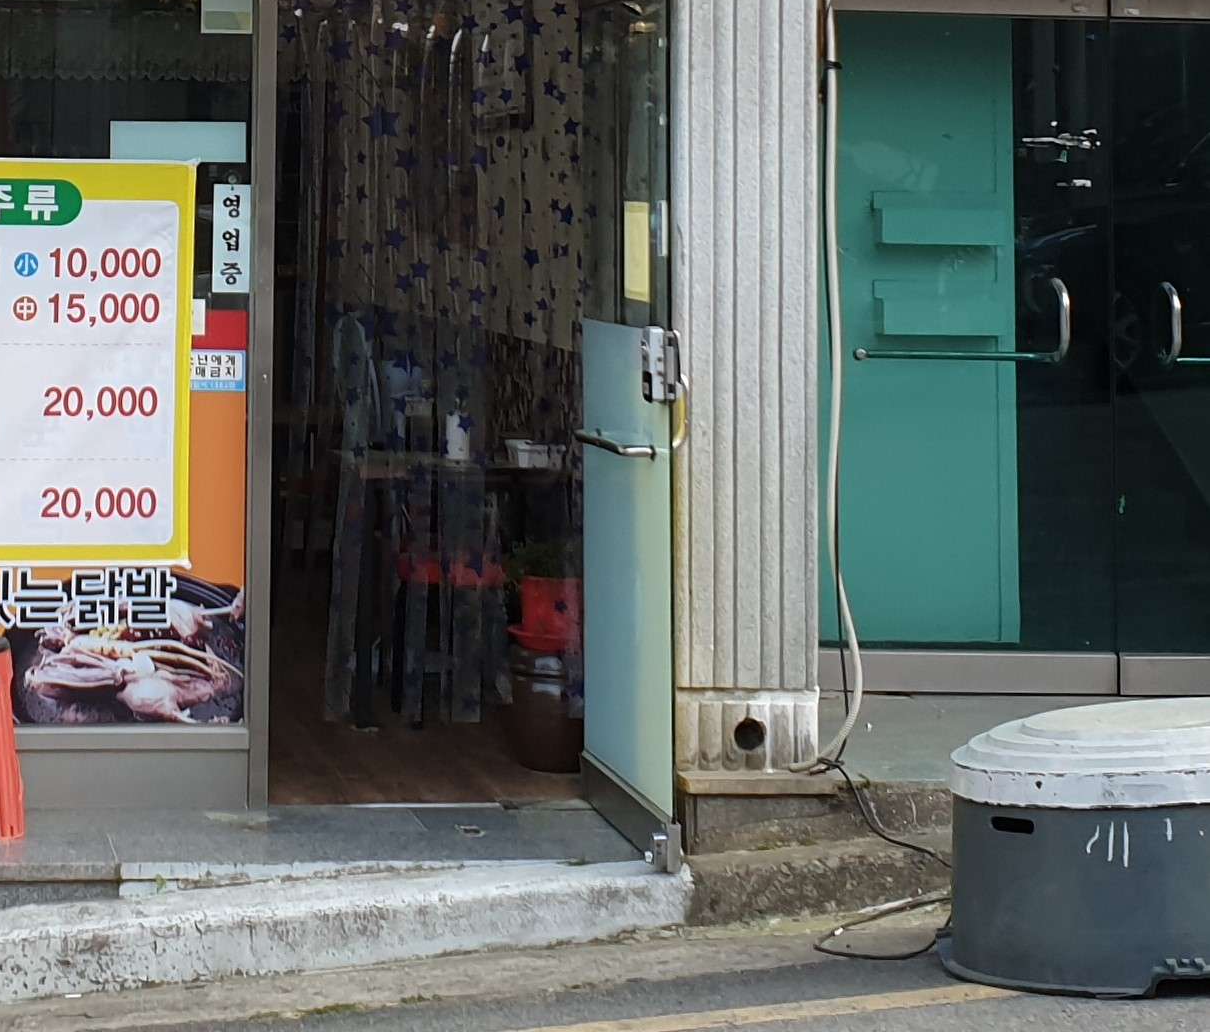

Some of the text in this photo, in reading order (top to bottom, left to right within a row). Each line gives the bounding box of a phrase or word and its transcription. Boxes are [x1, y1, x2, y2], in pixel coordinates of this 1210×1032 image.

[49, 247, 162, 282] 10,000
[47, 293, 161, 327] 15,000
[190, 366, 236, 378] 매금지
[43, 386, 159, 420] 20,000
[40, 487, 157, 522] 20,000
